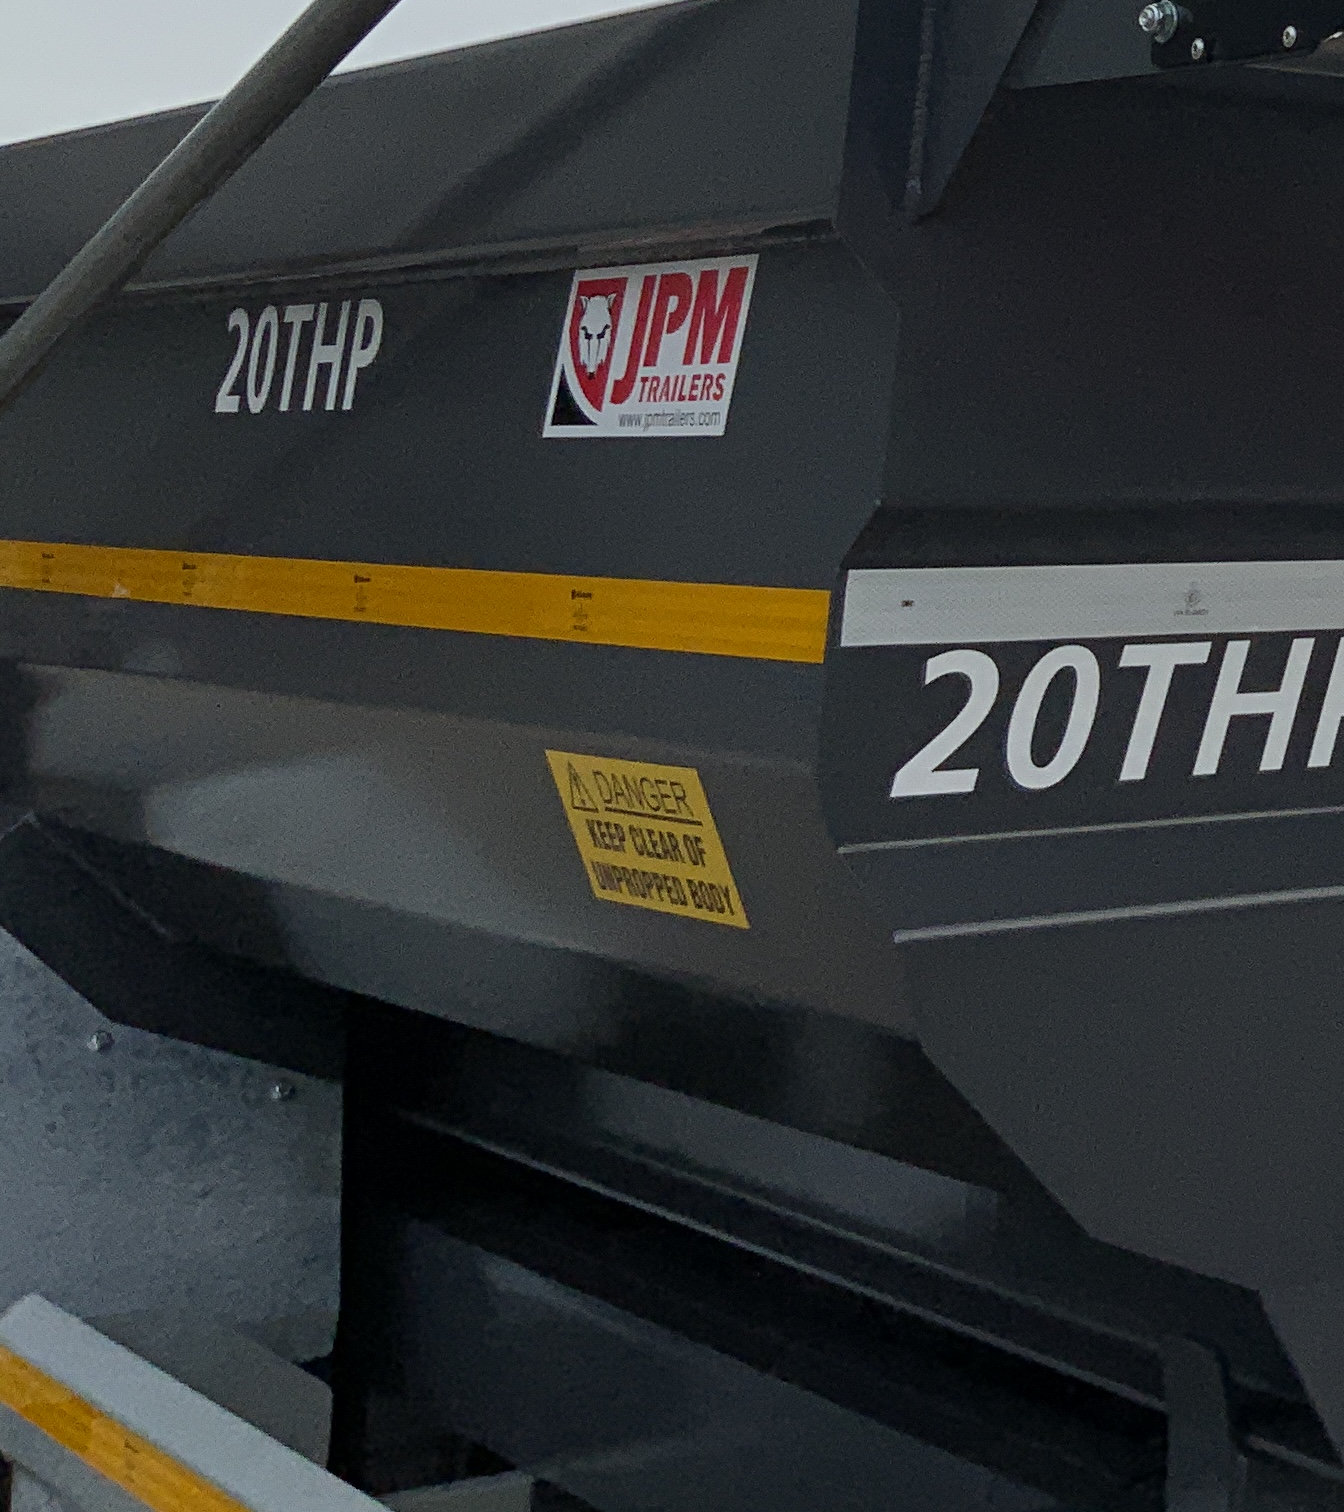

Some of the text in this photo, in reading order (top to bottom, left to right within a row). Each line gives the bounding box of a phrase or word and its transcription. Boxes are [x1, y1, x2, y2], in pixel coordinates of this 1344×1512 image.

[215, 298, 384, 414] 20THP
[610, 266, 749, 405] JPM
[638, 373, 727, 403] TRAILERS
[617, 409, 722, 432] www.jpmtrailers.com
[592, 770, 695, 818] DANGER
[586, 818, 707, 868] KEEP CLEAR OF
[591, 861, 735, 916] UNPROPPED BODY
